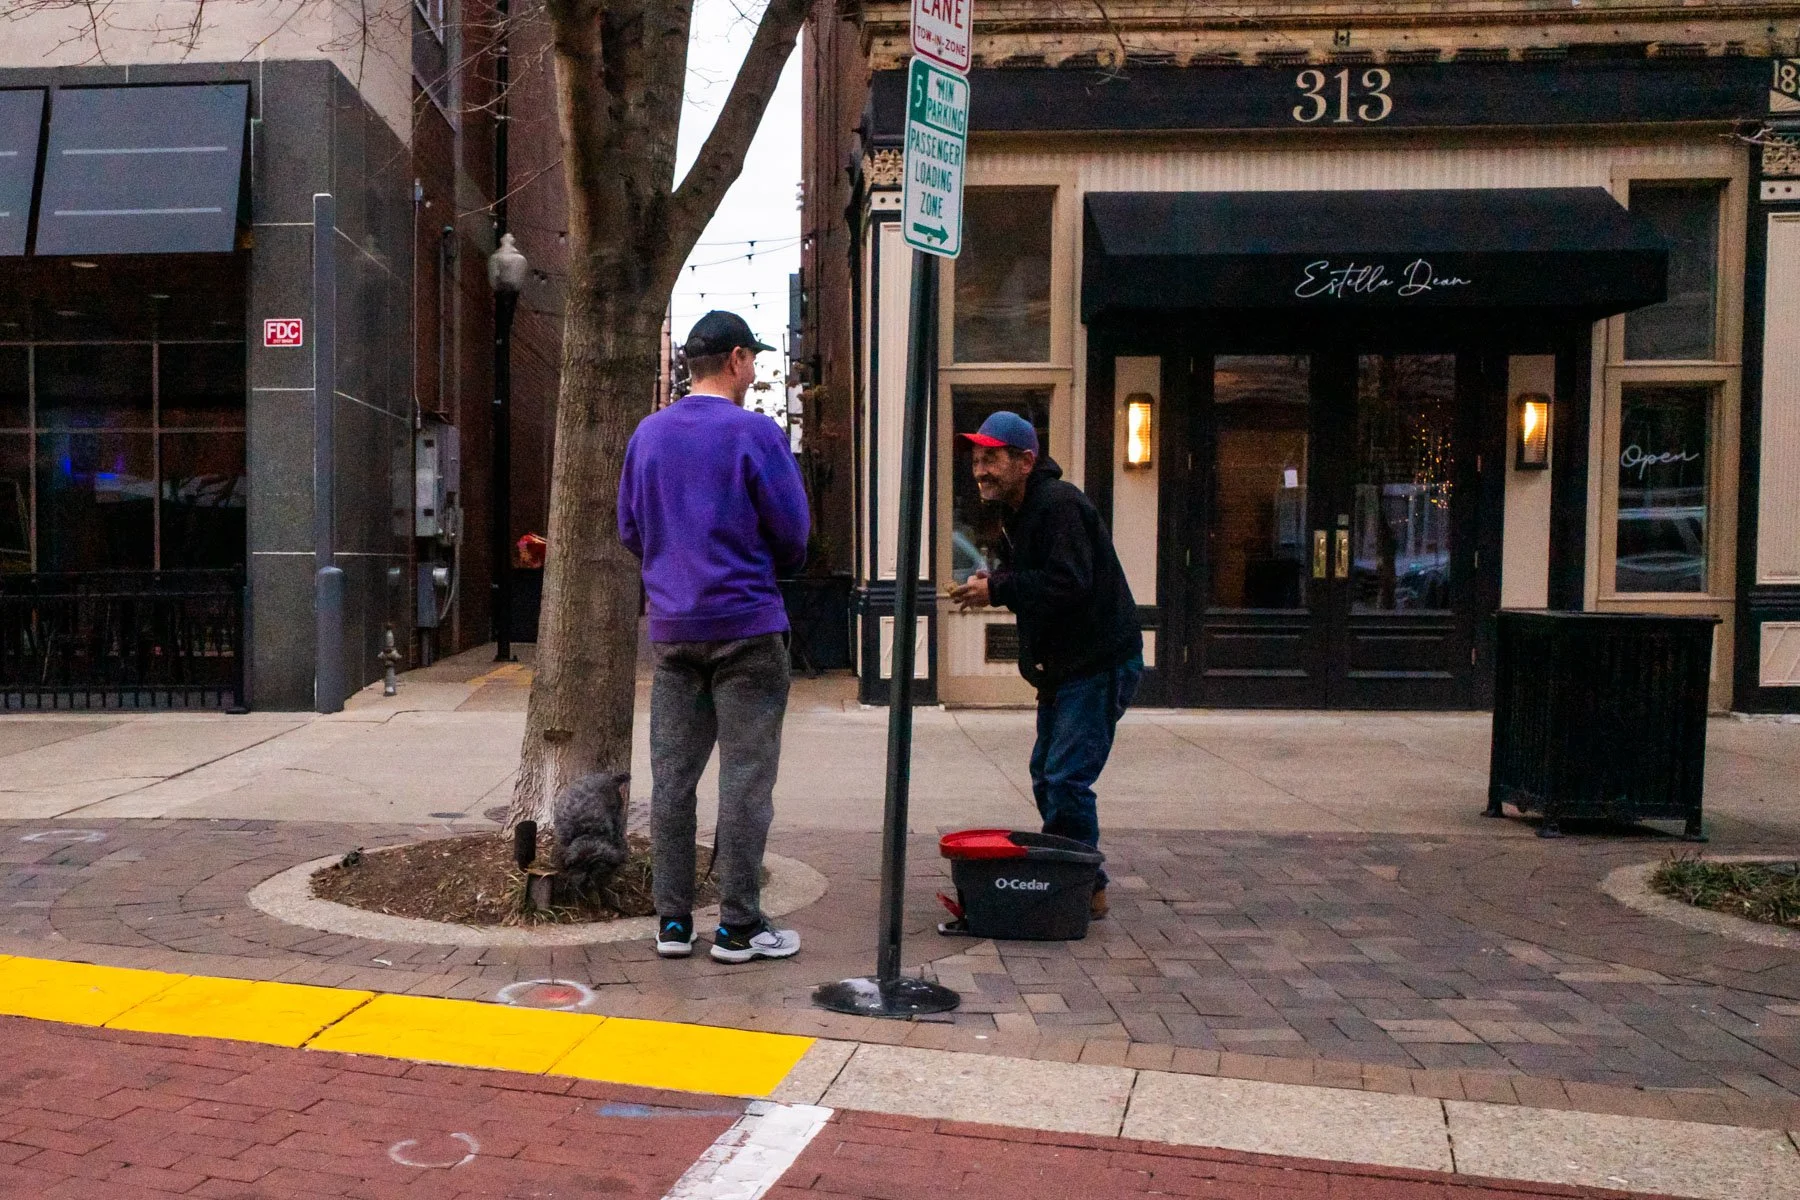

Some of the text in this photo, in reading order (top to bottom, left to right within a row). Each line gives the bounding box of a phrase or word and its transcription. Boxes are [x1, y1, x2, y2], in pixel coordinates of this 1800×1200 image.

[915, 75, 954, 108] 5 MIN
[1292, 68, 1393, 123] 313
[1773, 60, 1800, 97] 18
[927, 97, 963, 132] PARKING
[909, 128, 961, 167] PASSENGER
[915, 160, 953, 193] LOADING
[920, 192, 944, 219] ZONE
[1295, 258, 1472, 298] Estella Dean
[267, 321, 299, 339] FDC
[1620, 444, 1700, 480] Open
[995, 877, 1050, 891] O-Cedar
